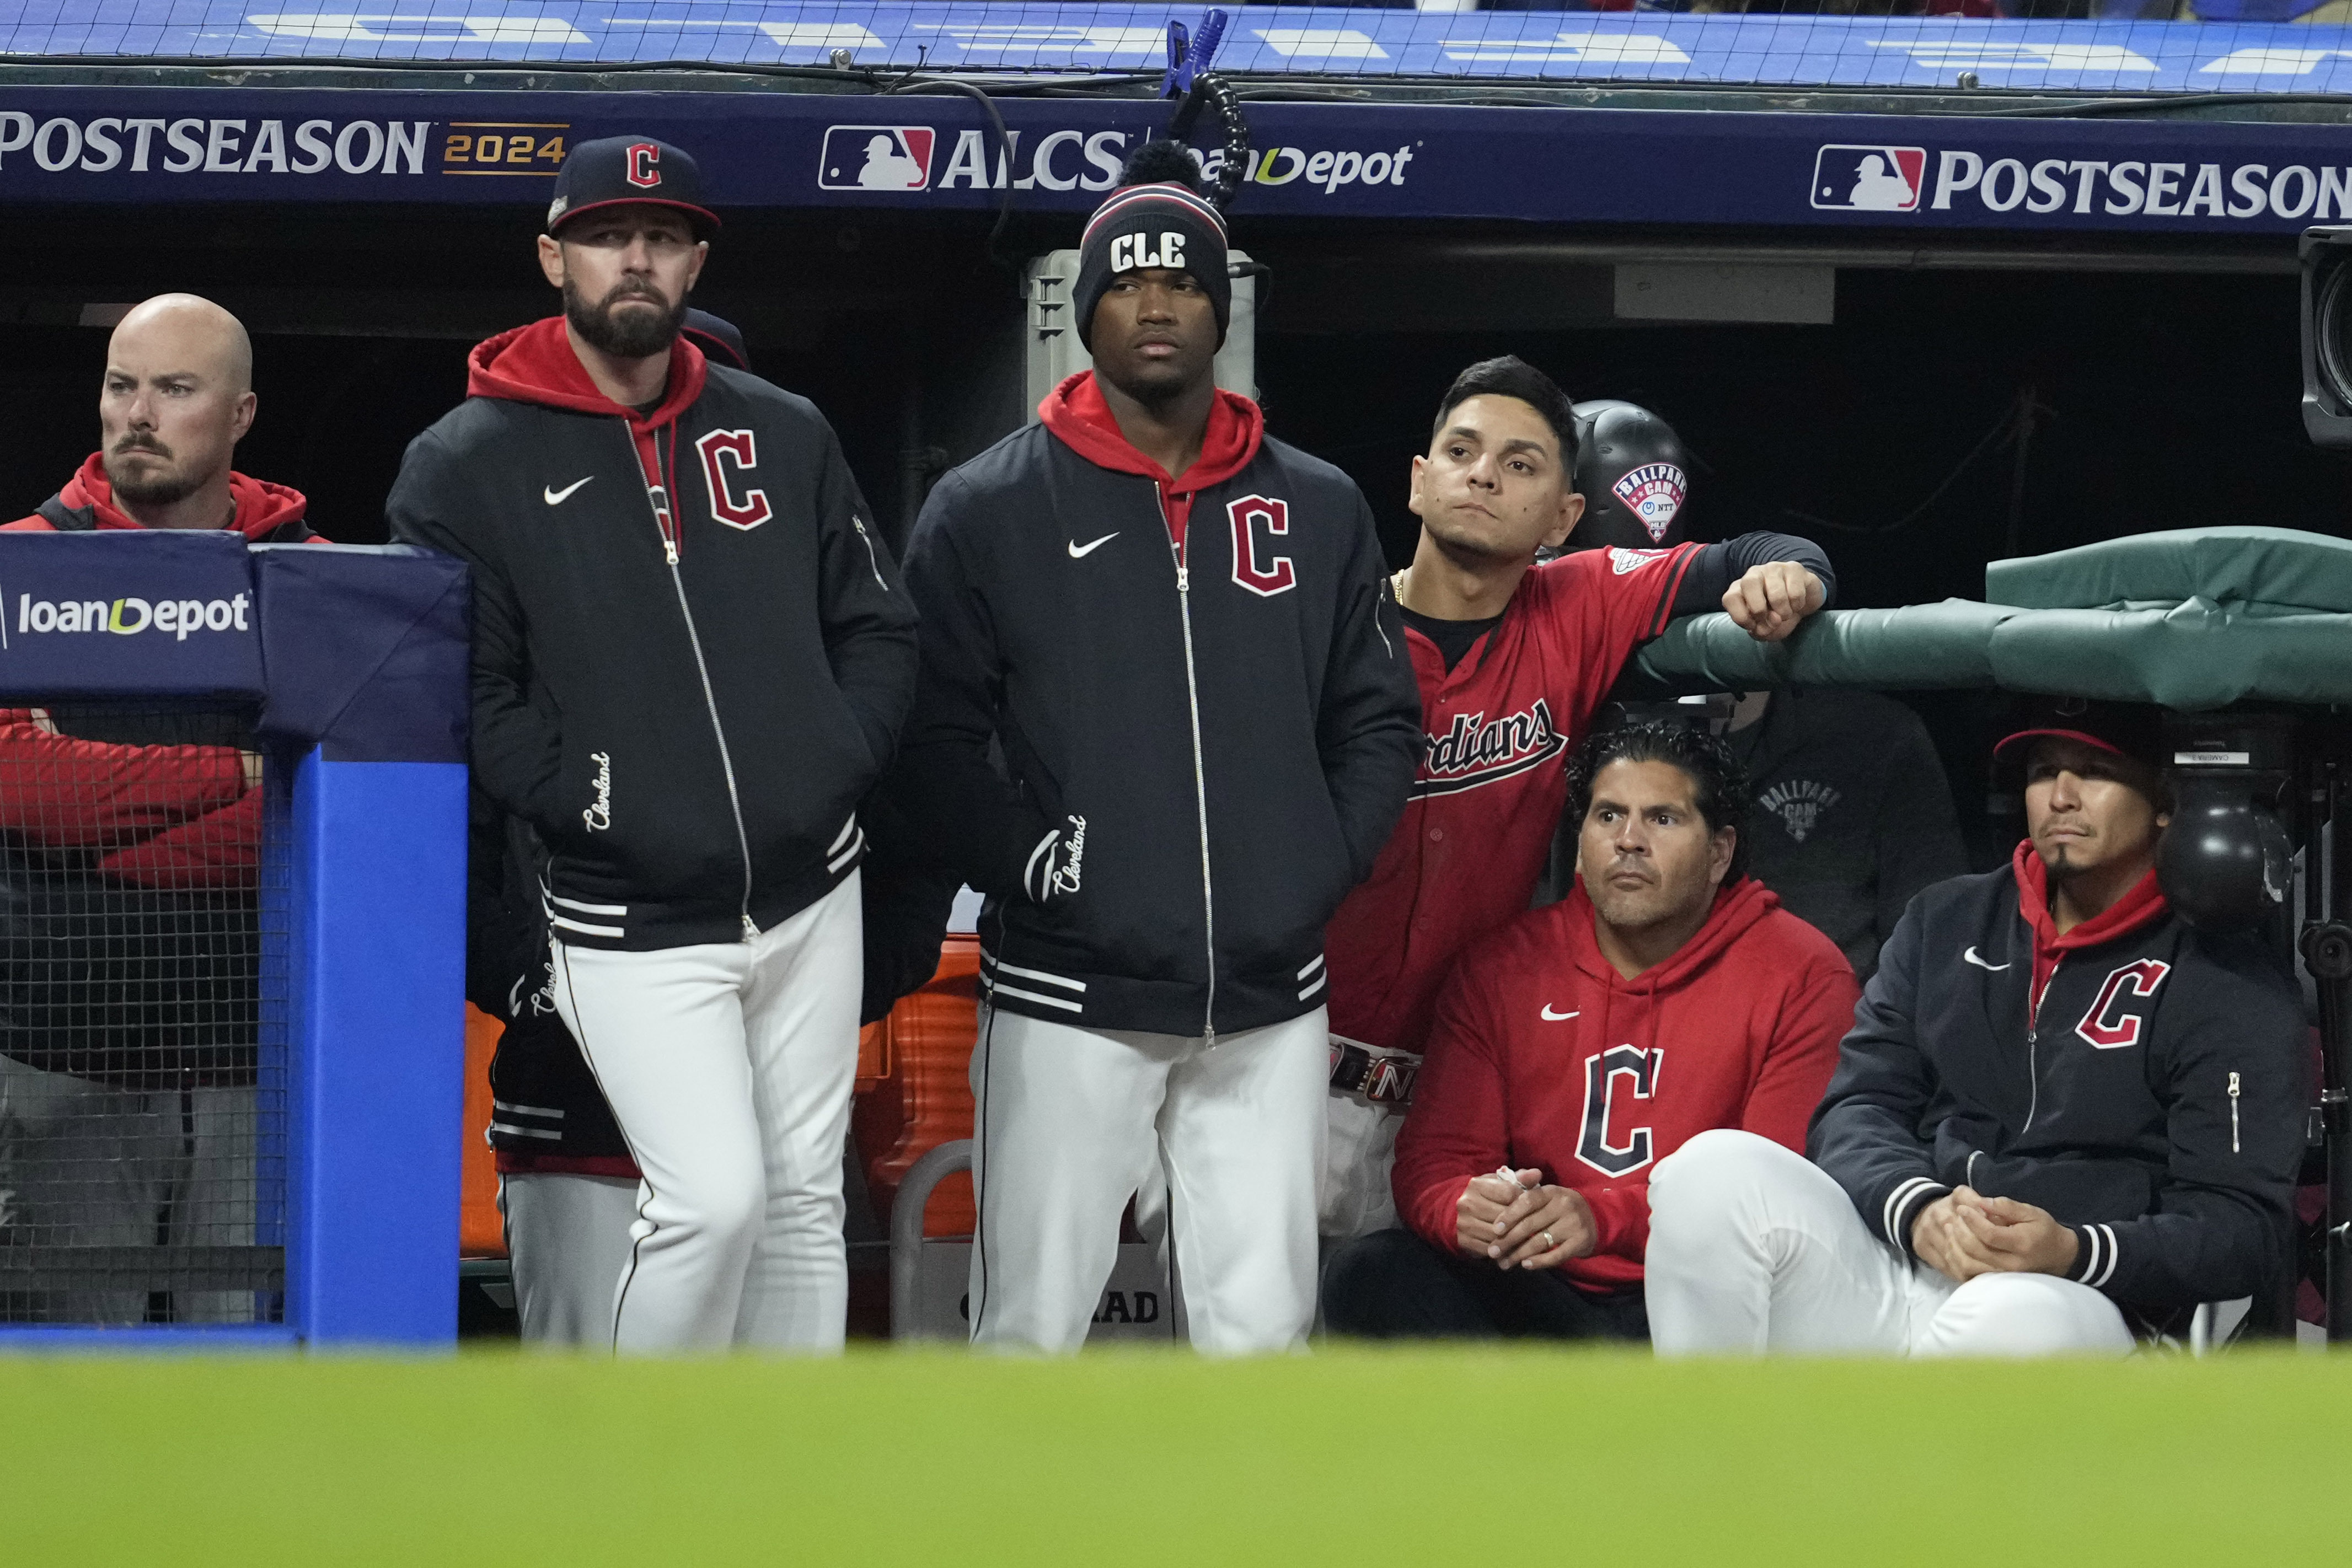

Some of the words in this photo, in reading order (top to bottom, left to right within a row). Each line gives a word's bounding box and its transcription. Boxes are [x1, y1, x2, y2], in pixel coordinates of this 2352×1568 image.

[0, 111, 431, 175] POSTSEASON
[444, 135, 566, 163] 2024
[626, 143, 662, 189] C
[937, 130, 1125, 191] ALCS
[1931, 150, 2352, 219] POSTSEASON
[1111, 232, 1186, 273] CLE
[695, 428, 773, 531] C
[1619, 466, 1686, 496] BALLPARK
[1644, 481, 1673, 496] CAM
[1658, 503, 1674, 512] NTT
[1226, 493, 1296, 597] C
[19, 593, 249, 641] loanDepot
[582, 751, 611, 833] Cleveland
[1759, 779, 1842, 812] BALLPARK
[1052, 815, 1086, 894] Cleveland
[2075, 958, 2171, 1049] C
[1574, 1043, 1664, 1179] C
